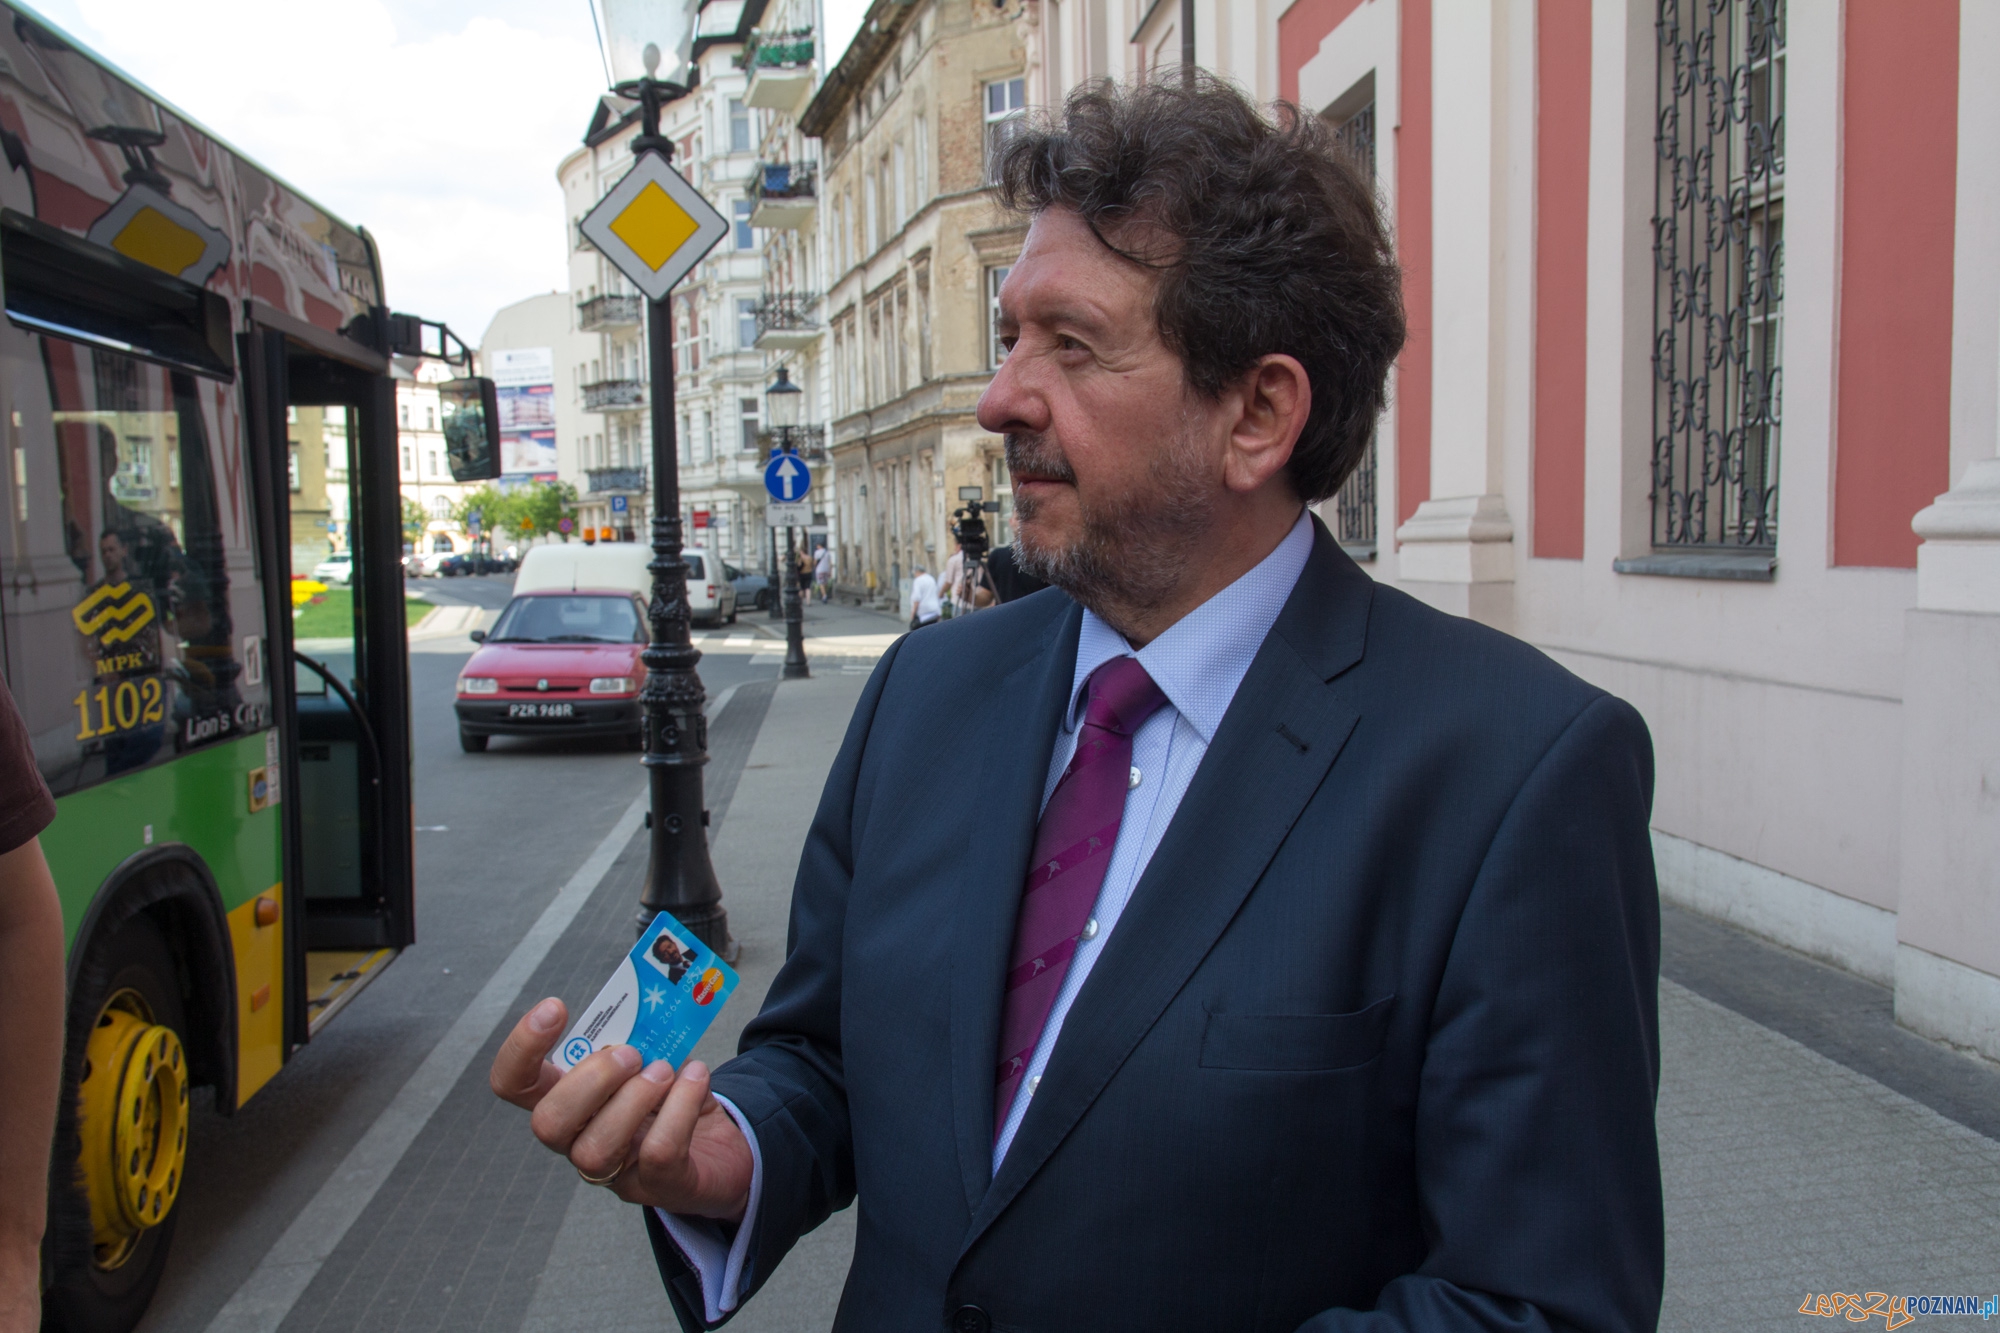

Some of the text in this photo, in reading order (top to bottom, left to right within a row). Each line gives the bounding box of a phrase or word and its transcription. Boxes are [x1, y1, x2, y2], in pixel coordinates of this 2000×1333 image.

[614, 497, 624, 510] P
[95, 652, 144, 675] MPK
[74, 677, 164, 741] 1102
[186, 702, 266, 742] Lion's City
[509, 703, 537, 717] PZR
[695, 969, 721, 1004] MasterCard
[660, 998, 681, 1025] 2664
